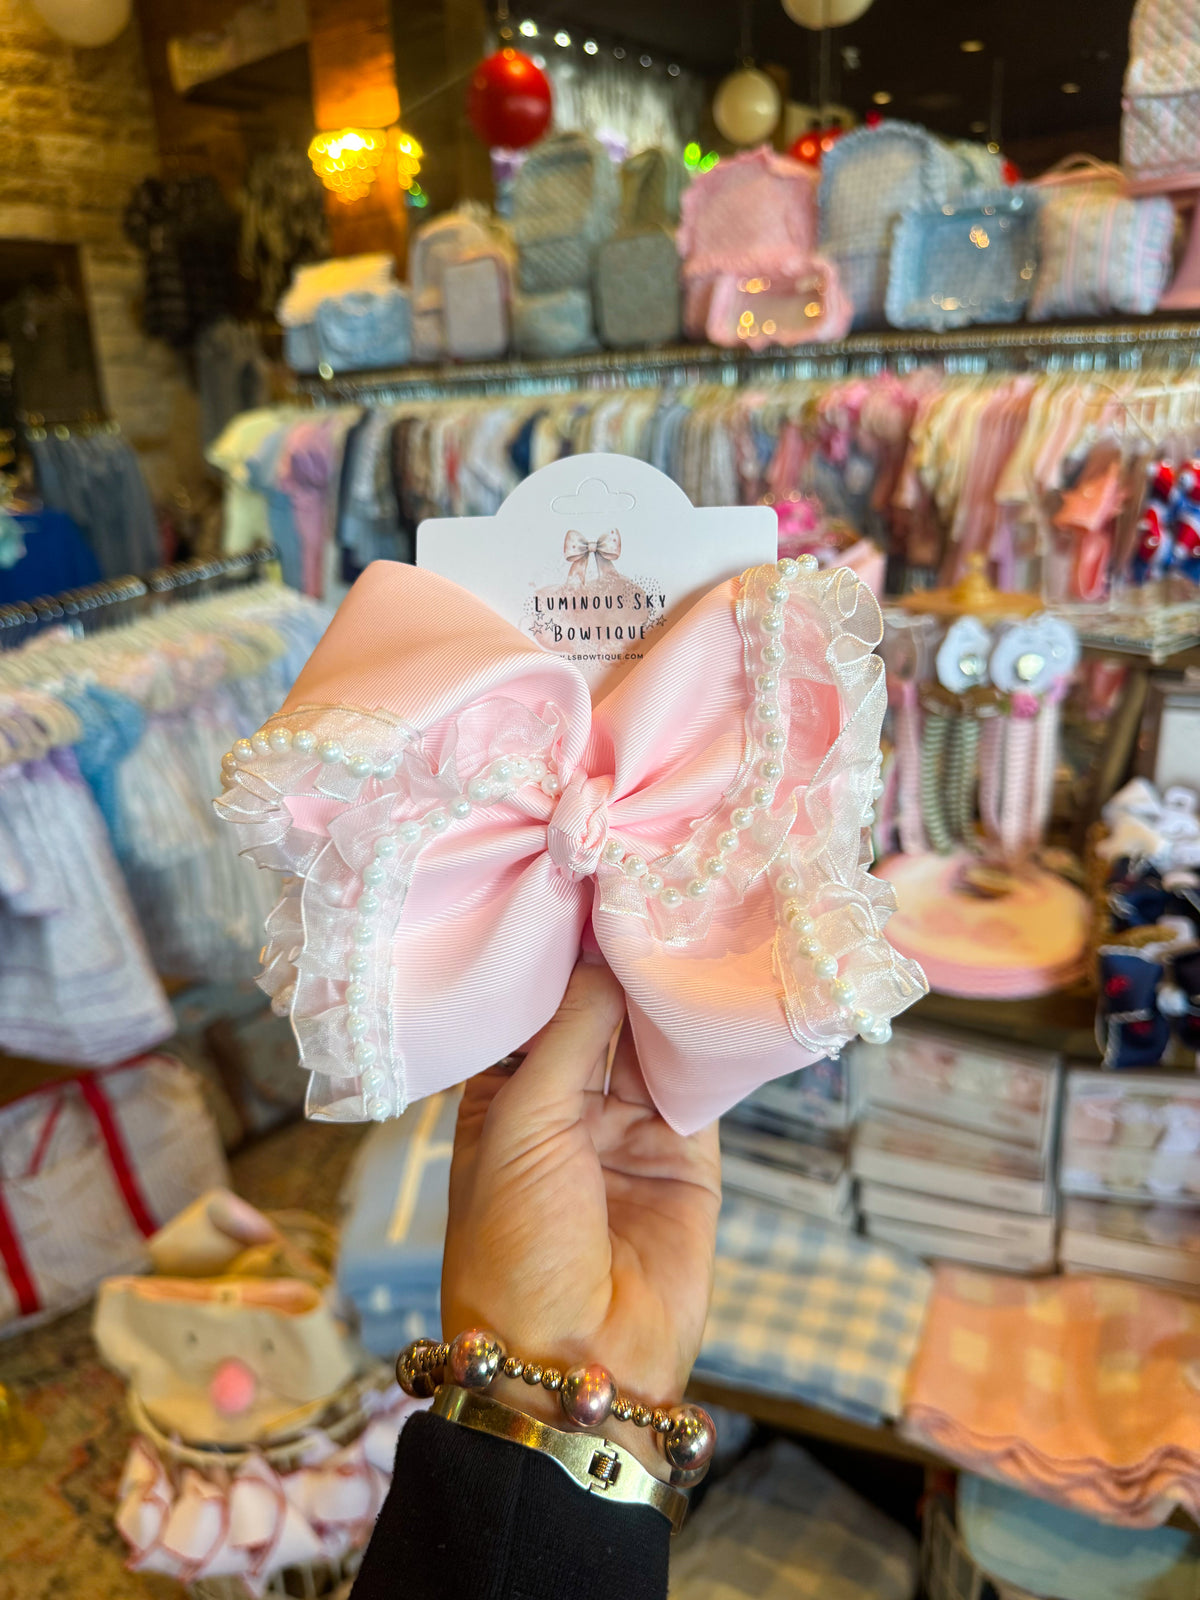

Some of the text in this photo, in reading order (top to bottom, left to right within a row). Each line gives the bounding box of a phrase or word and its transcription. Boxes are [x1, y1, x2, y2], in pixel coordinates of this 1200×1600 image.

[535, 593, 666, 612] LUMINOUS SKY
[554, 625, 646, 642] BOWTIQUE
